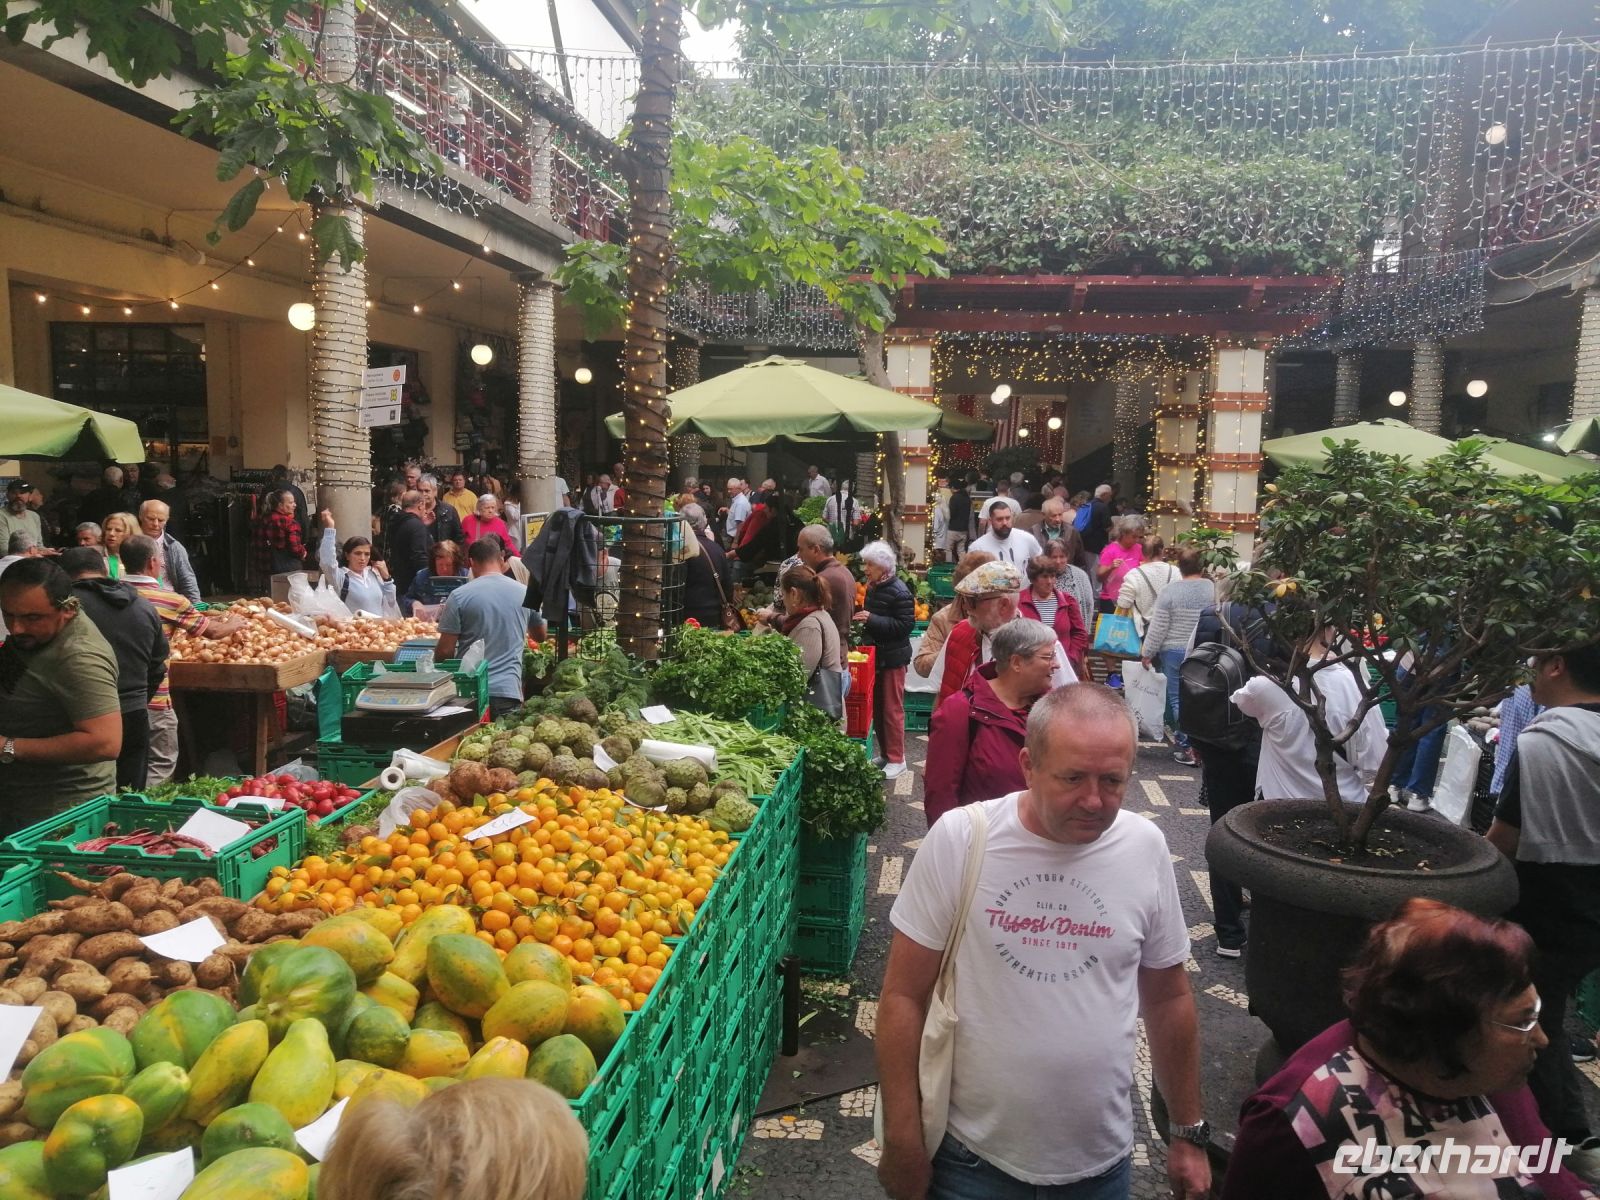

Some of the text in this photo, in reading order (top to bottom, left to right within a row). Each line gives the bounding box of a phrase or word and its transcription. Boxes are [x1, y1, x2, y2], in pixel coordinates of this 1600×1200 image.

[1013, 876, 1031, 890] FIT
[1036, 873, 1065, 883] YOUR
[1050, 917, 1116, 939] Denim
[1022, 936, 1051, 948] SINCE
[994, 942, 1099, 983] AUTHENTIC BRAND
